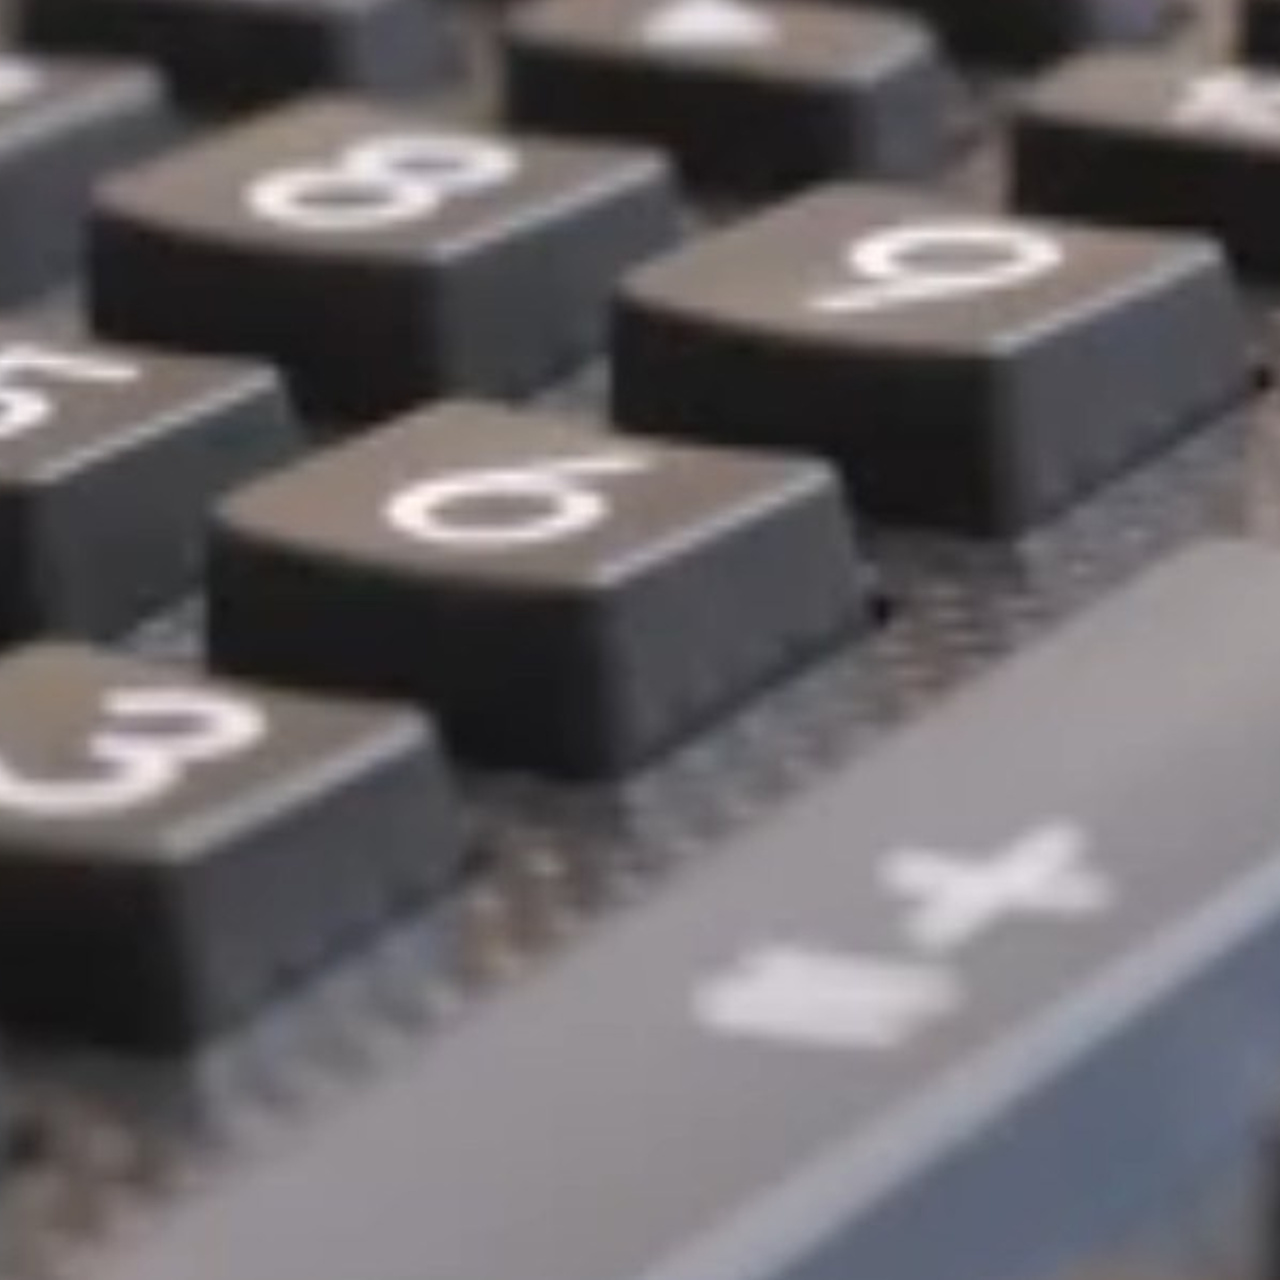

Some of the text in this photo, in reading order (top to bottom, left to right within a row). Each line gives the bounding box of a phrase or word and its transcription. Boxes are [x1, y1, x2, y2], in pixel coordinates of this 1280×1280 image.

[244, 132, 520, 234] 8
[808, 220, 1066, 314] 9
[384, 452, 654, 546] 6
